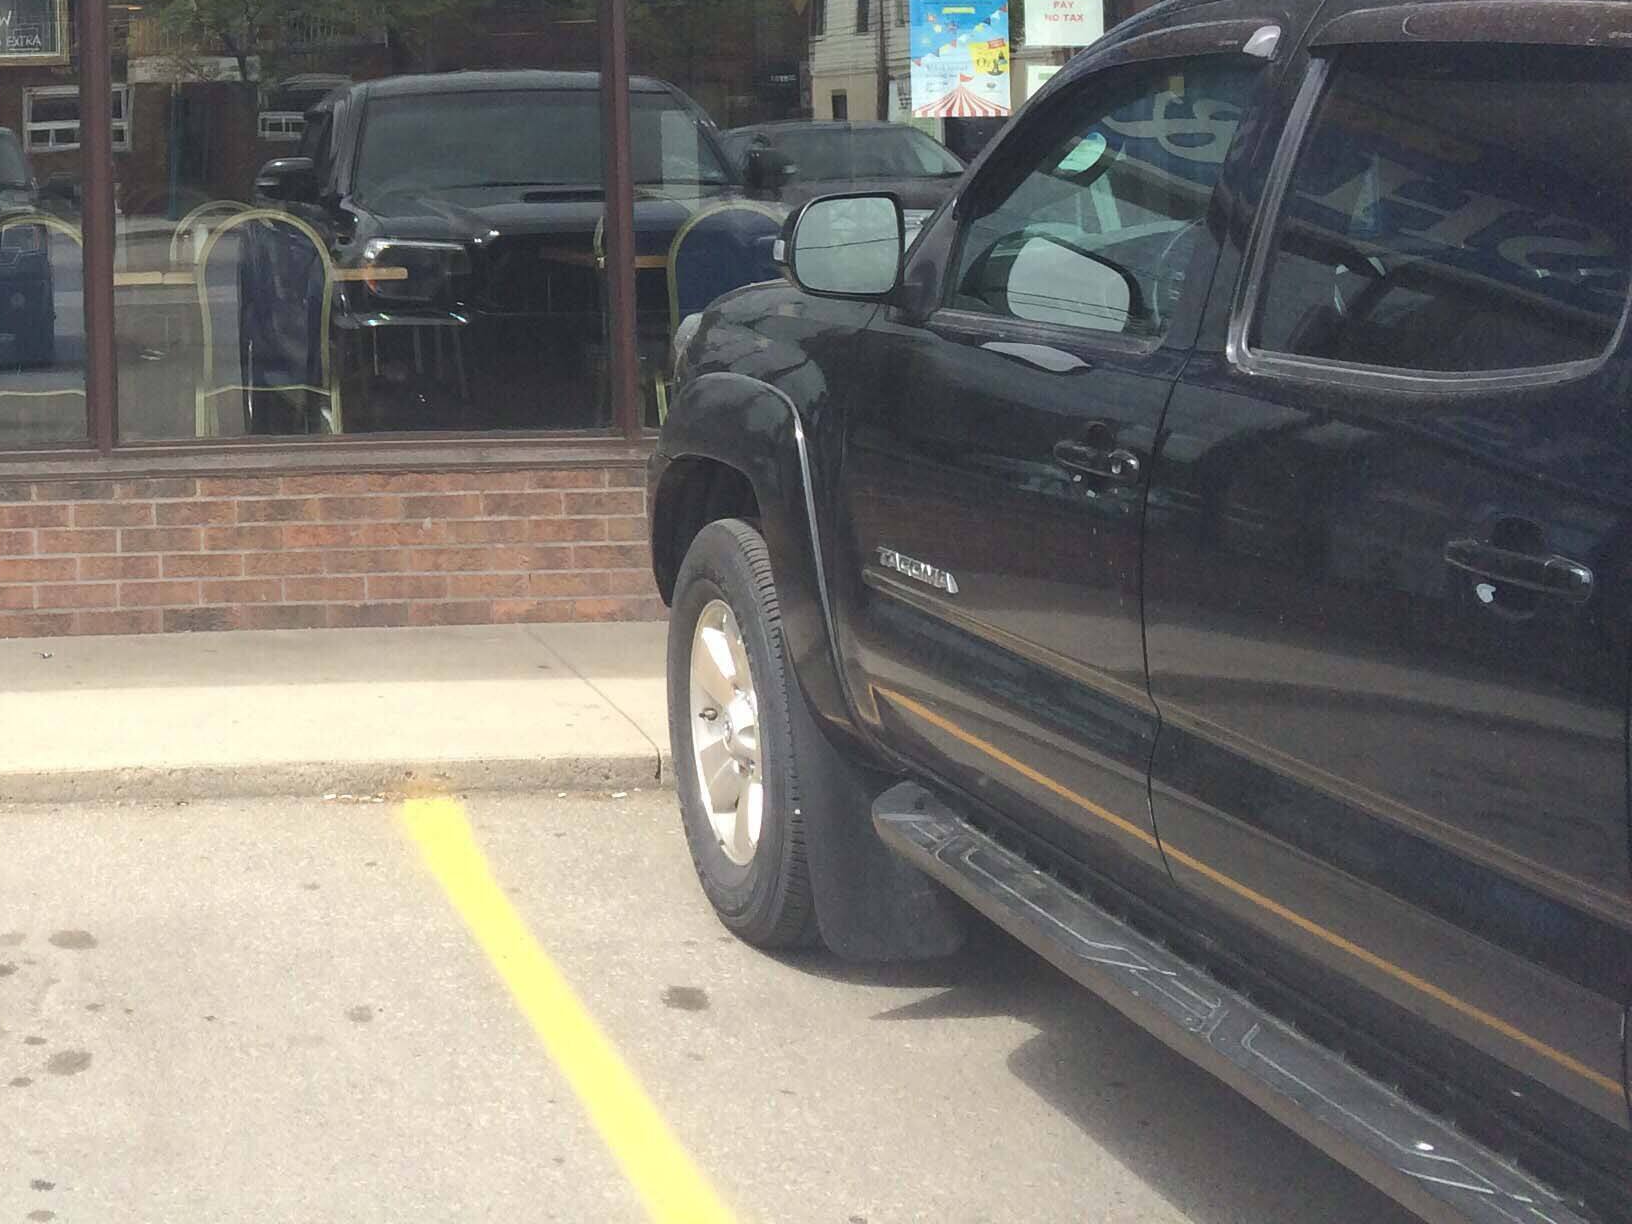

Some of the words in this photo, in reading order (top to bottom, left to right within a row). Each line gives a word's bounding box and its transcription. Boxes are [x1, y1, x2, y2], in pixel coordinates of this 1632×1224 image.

[1052, 1, 1074, 9] PAY
[1044, 14, 1060, 22] NO
[1063, 14, 1084, 22] TAX
